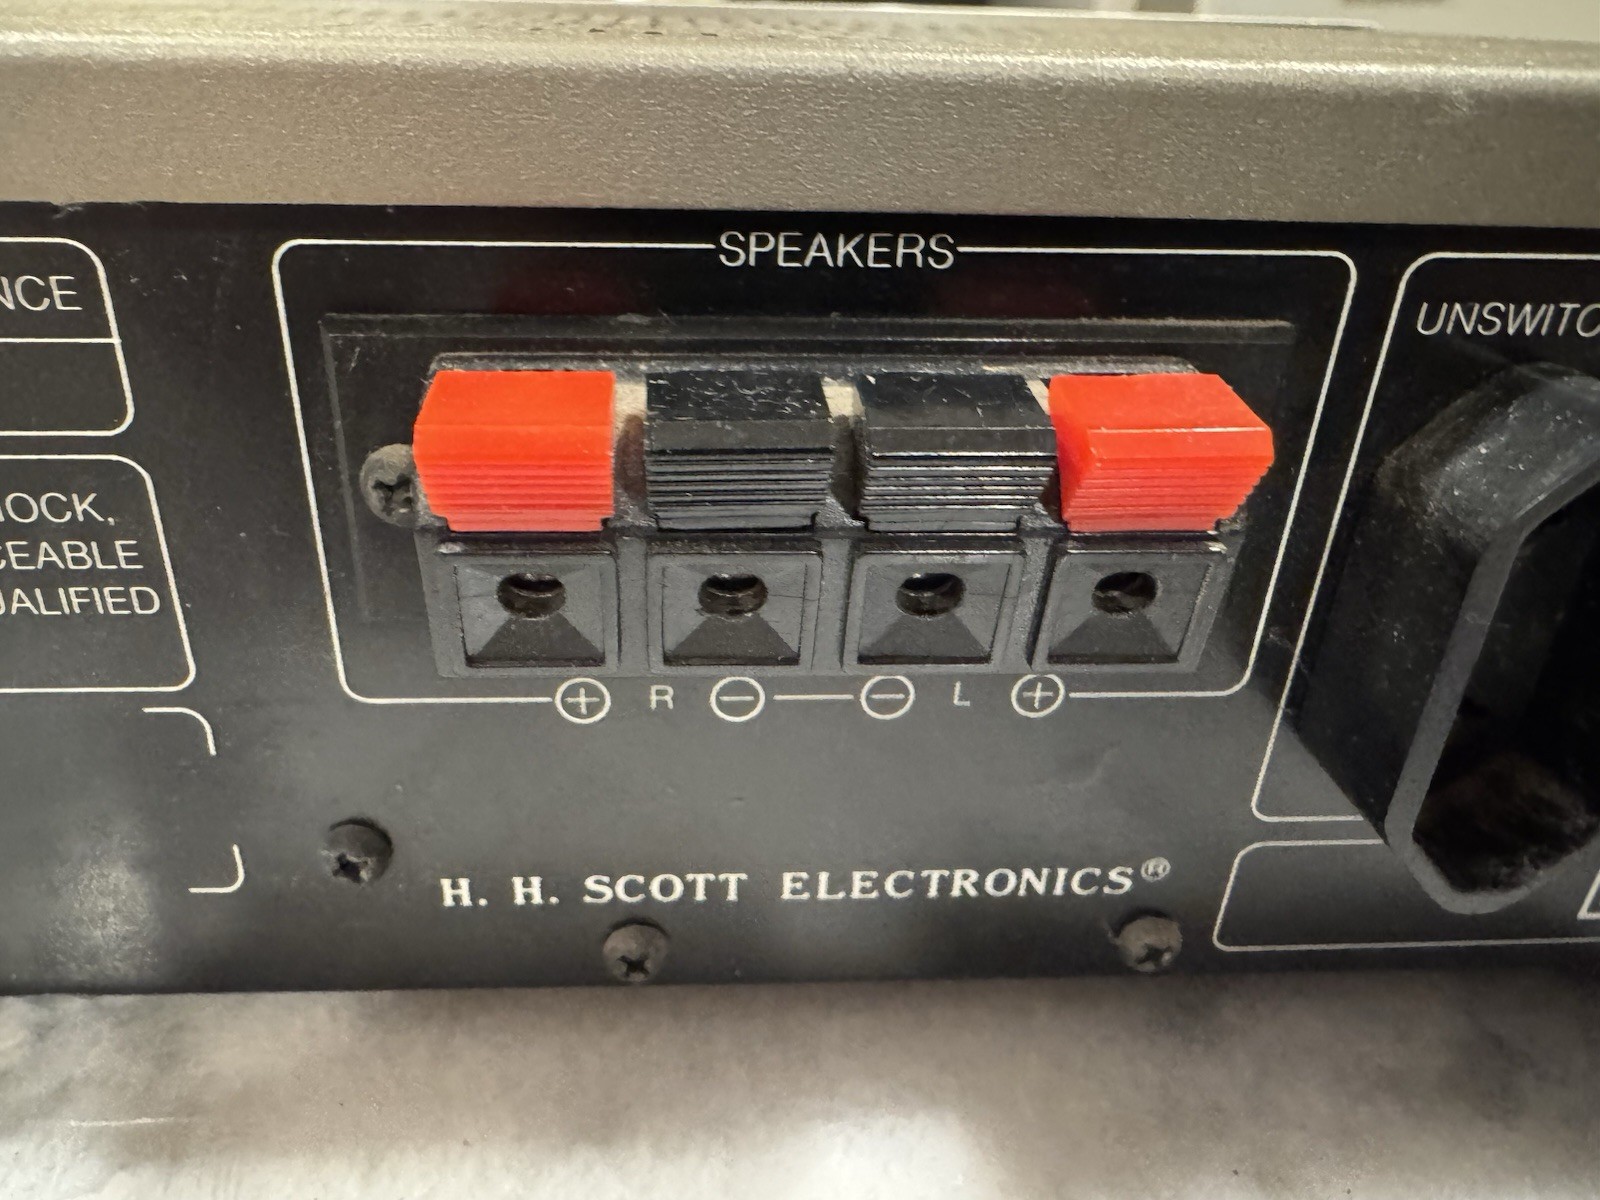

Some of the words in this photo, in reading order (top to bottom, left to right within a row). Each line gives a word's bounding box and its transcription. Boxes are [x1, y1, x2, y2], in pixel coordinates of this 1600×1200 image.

[719, 231, 955, 269] SPEAKERS
[0, 492, 115, 526] OCK,
[0, 540, 144, 570] EABLE
[0, 586, 161, 615] ALIFIED
[649, 684, 674, 710] R
[953, 681, 971, 707] L
[439, 876, 488, 907] H.
[511, 875, 560, 906] H.
[582, 872, 749, 903] SCOTT
